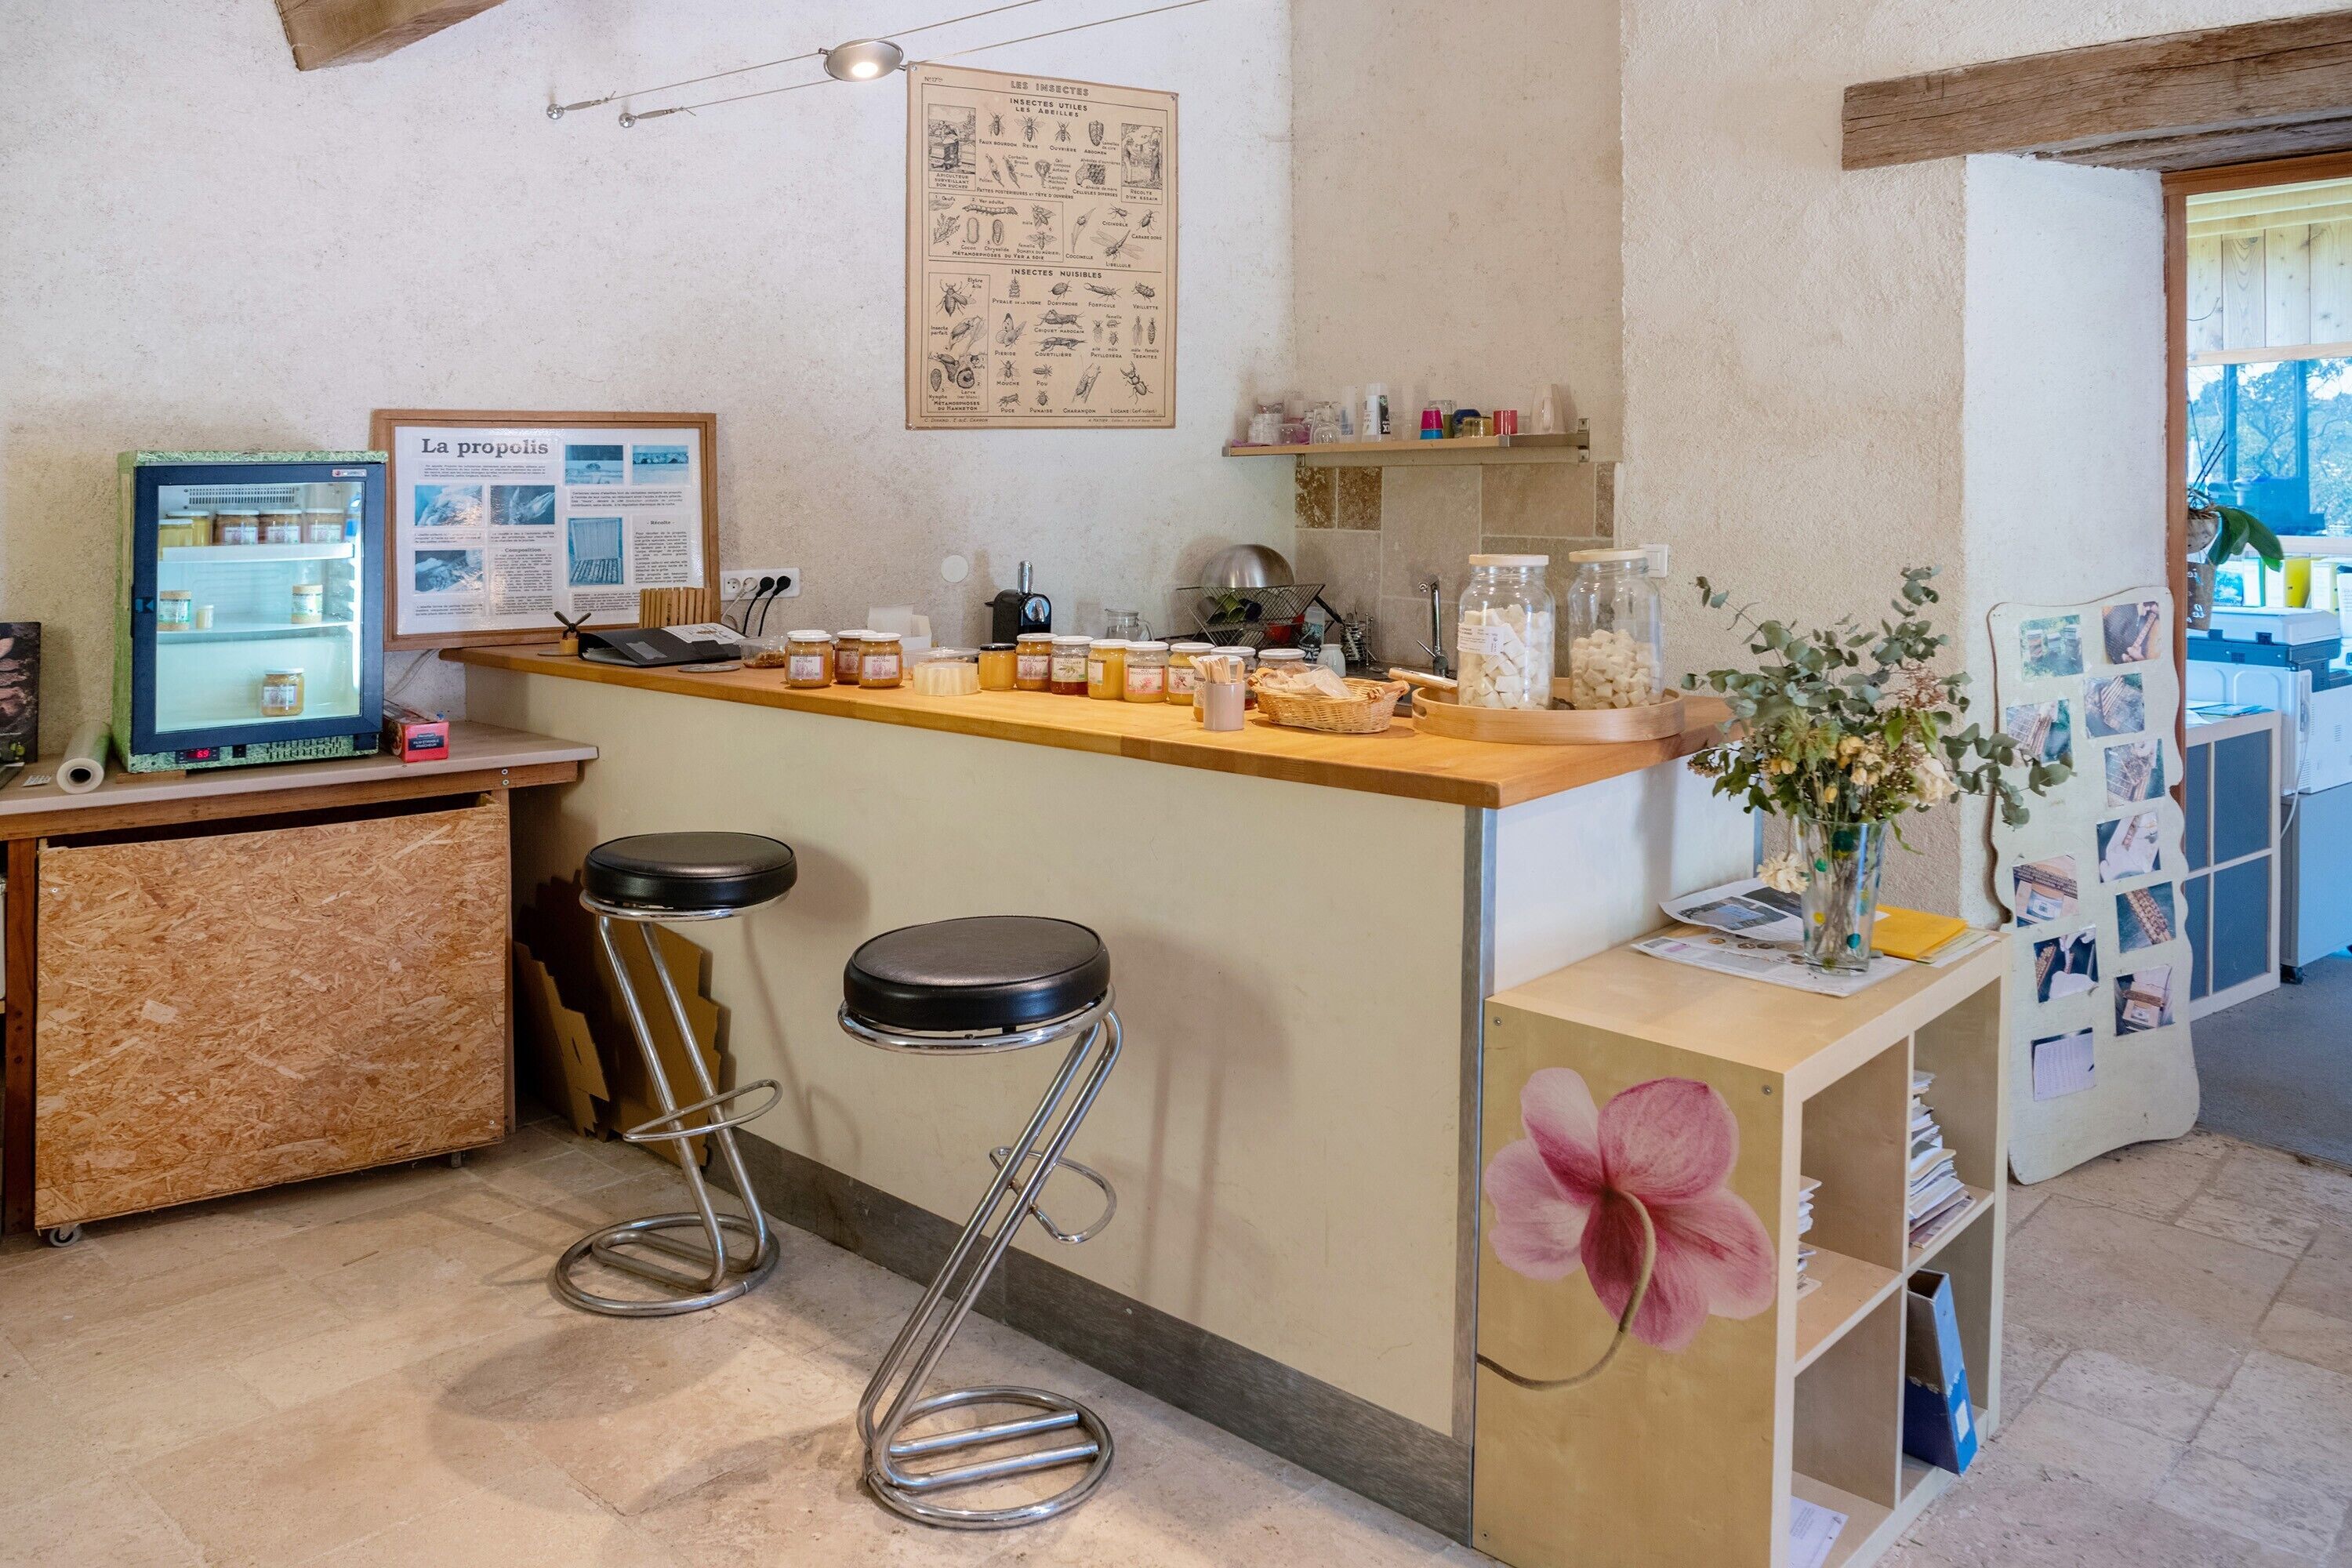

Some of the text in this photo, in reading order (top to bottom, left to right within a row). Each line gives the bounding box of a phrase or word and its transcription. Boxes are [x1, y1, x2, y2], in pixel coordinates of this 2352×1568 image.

[1011, 81, 1089, 96] LES INSECTES
[1010, 98, 1088, 111] INSECTES UTILES
[1038, 108, 1079, 117] ABEILLES
[421, 438, 548, 458] La propolis
